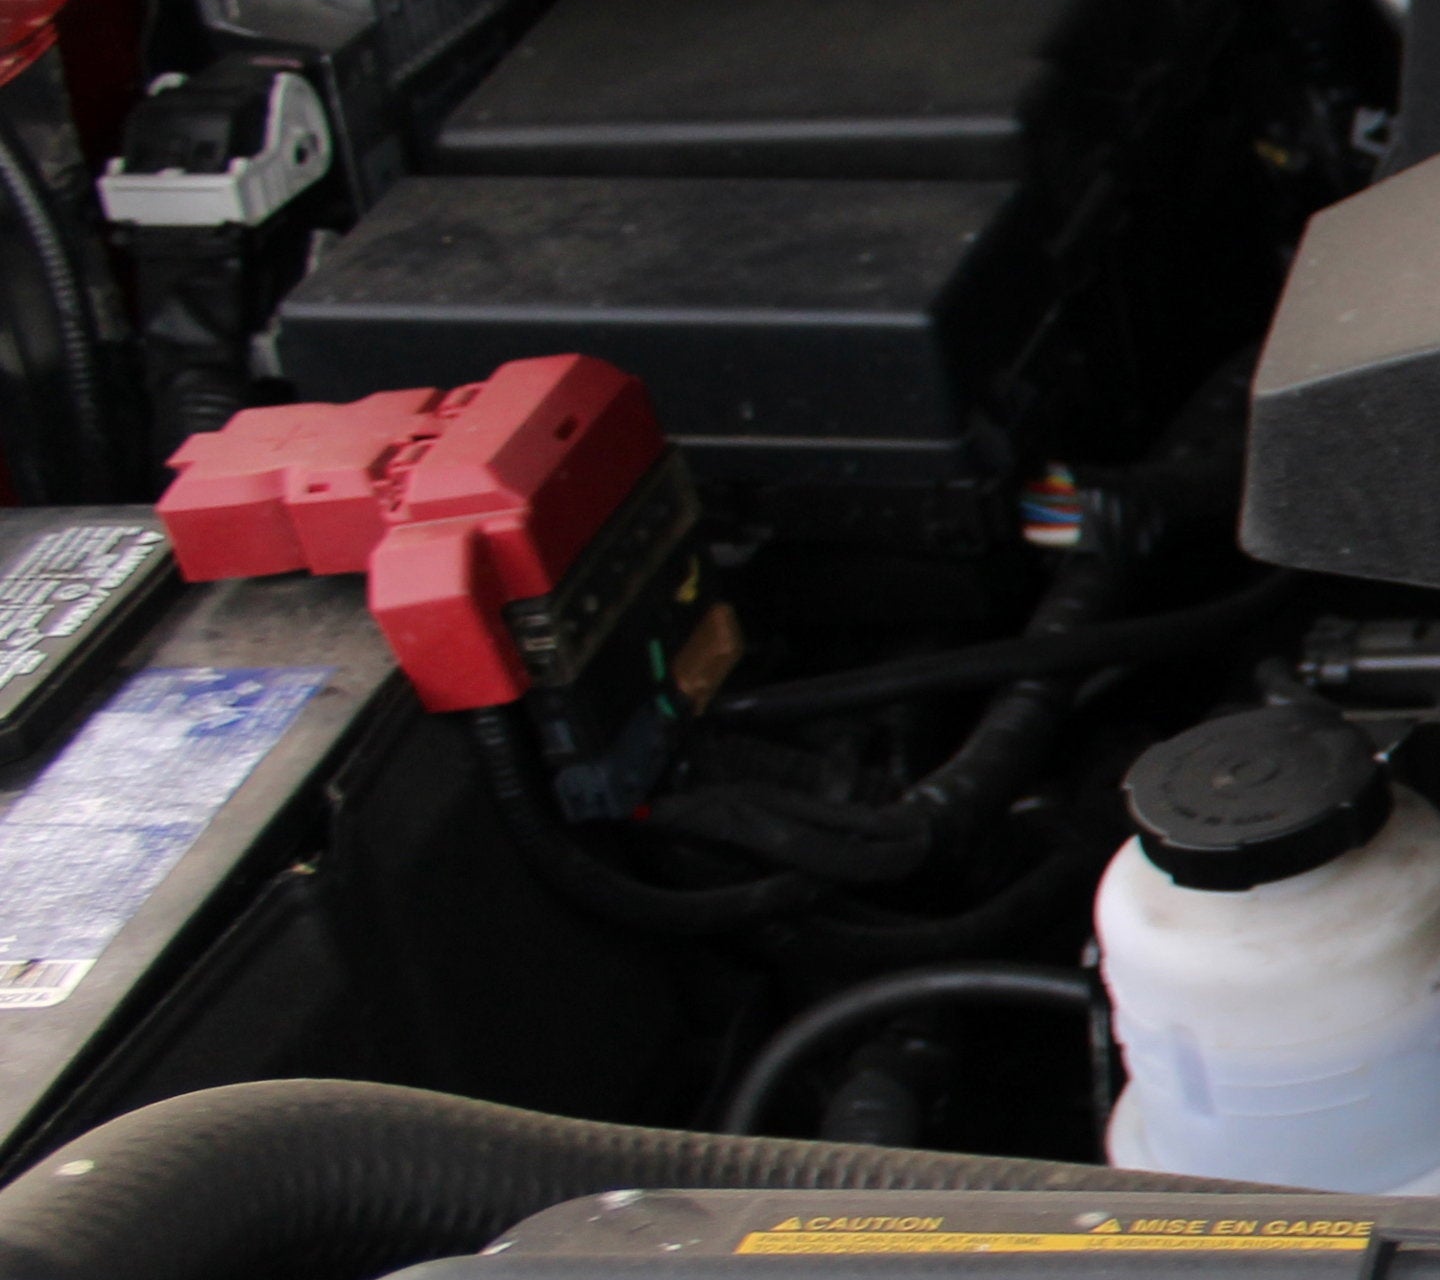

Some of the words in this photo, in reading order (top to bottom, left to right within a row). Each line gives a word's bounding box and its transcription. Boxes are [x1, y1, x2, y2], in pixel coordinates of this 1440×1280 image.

[806, 1216, 944, 1231] CAUTION
[1128, 1220, 1208, 1234] MISE
[1211, 1220, 1257, 1234] EN
[1261, 1221, 1375, 1236] GARDE
